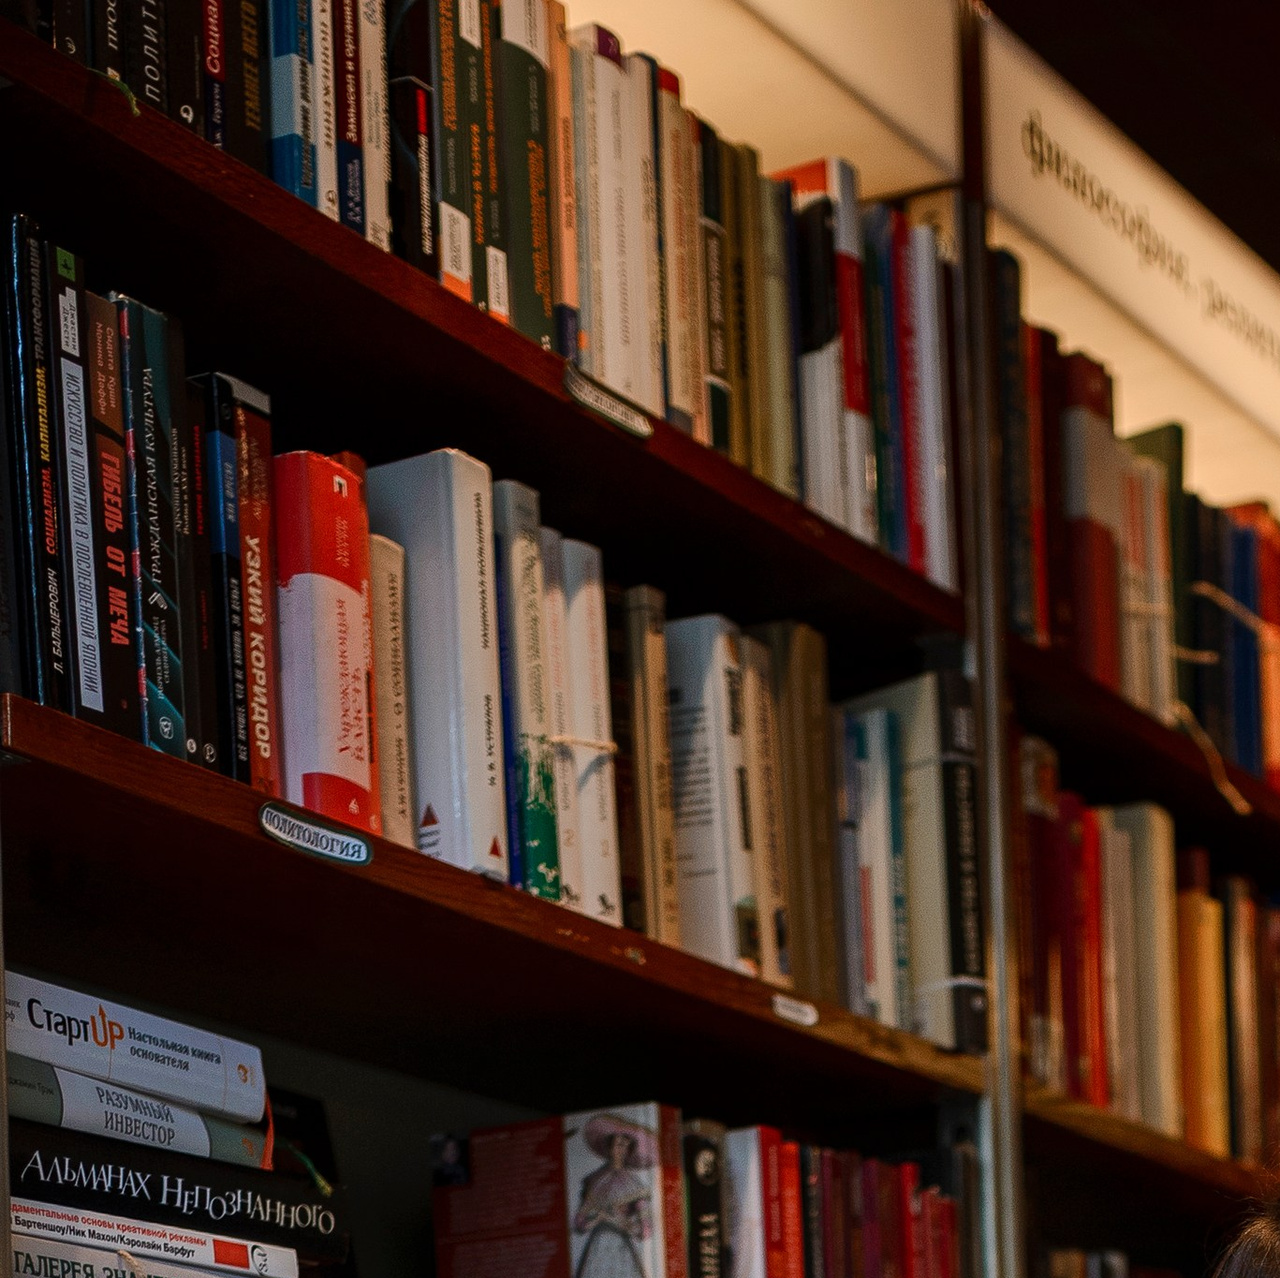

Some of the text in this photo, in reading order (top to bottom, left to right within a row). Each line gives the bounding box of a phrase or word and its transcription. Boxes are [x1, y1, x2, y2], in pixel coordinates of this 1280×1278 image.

[29, 238, 44, 360] ТРАНСФОРМАЦИЯ
[95, 323, 107, 415] Моника Даффи
[107, 376, 117, 408] Куши
[141, 367, 163, 583] ГРАЖДАНСКАЯ КУЛЬТУРА
[66, 373, 100, 693] ИСКУССТВО И ПОЛИТИКА В ПОСЛЕВОЕННОЙ ЯПОНИИ
[101, 452, 129, 645] ГИБЕЛЬ ОТ МЕЧА
[46, 568, 63, 657] БАЛЬЦЕРОВИЧ
[245, 534, 267, 626] УЗКИЙ
[249, 631, 271, 759] КОРИДОР
[265, 810, 362, 858] ПОЛИТОЛОГИЯ
[28, 998, 221, 1065] СтартUP Настольная книга
[129, 1045, 190, 1072] основателя
[95, 1085, 175, 1124] РАЗУМНЫЙ
[104, 1110, 175, 1146] ИНВЕСТОР
[81, 1216, 207, 1247] основы креативной рекламы
[163, 1244, 195, 1259] Барфут
